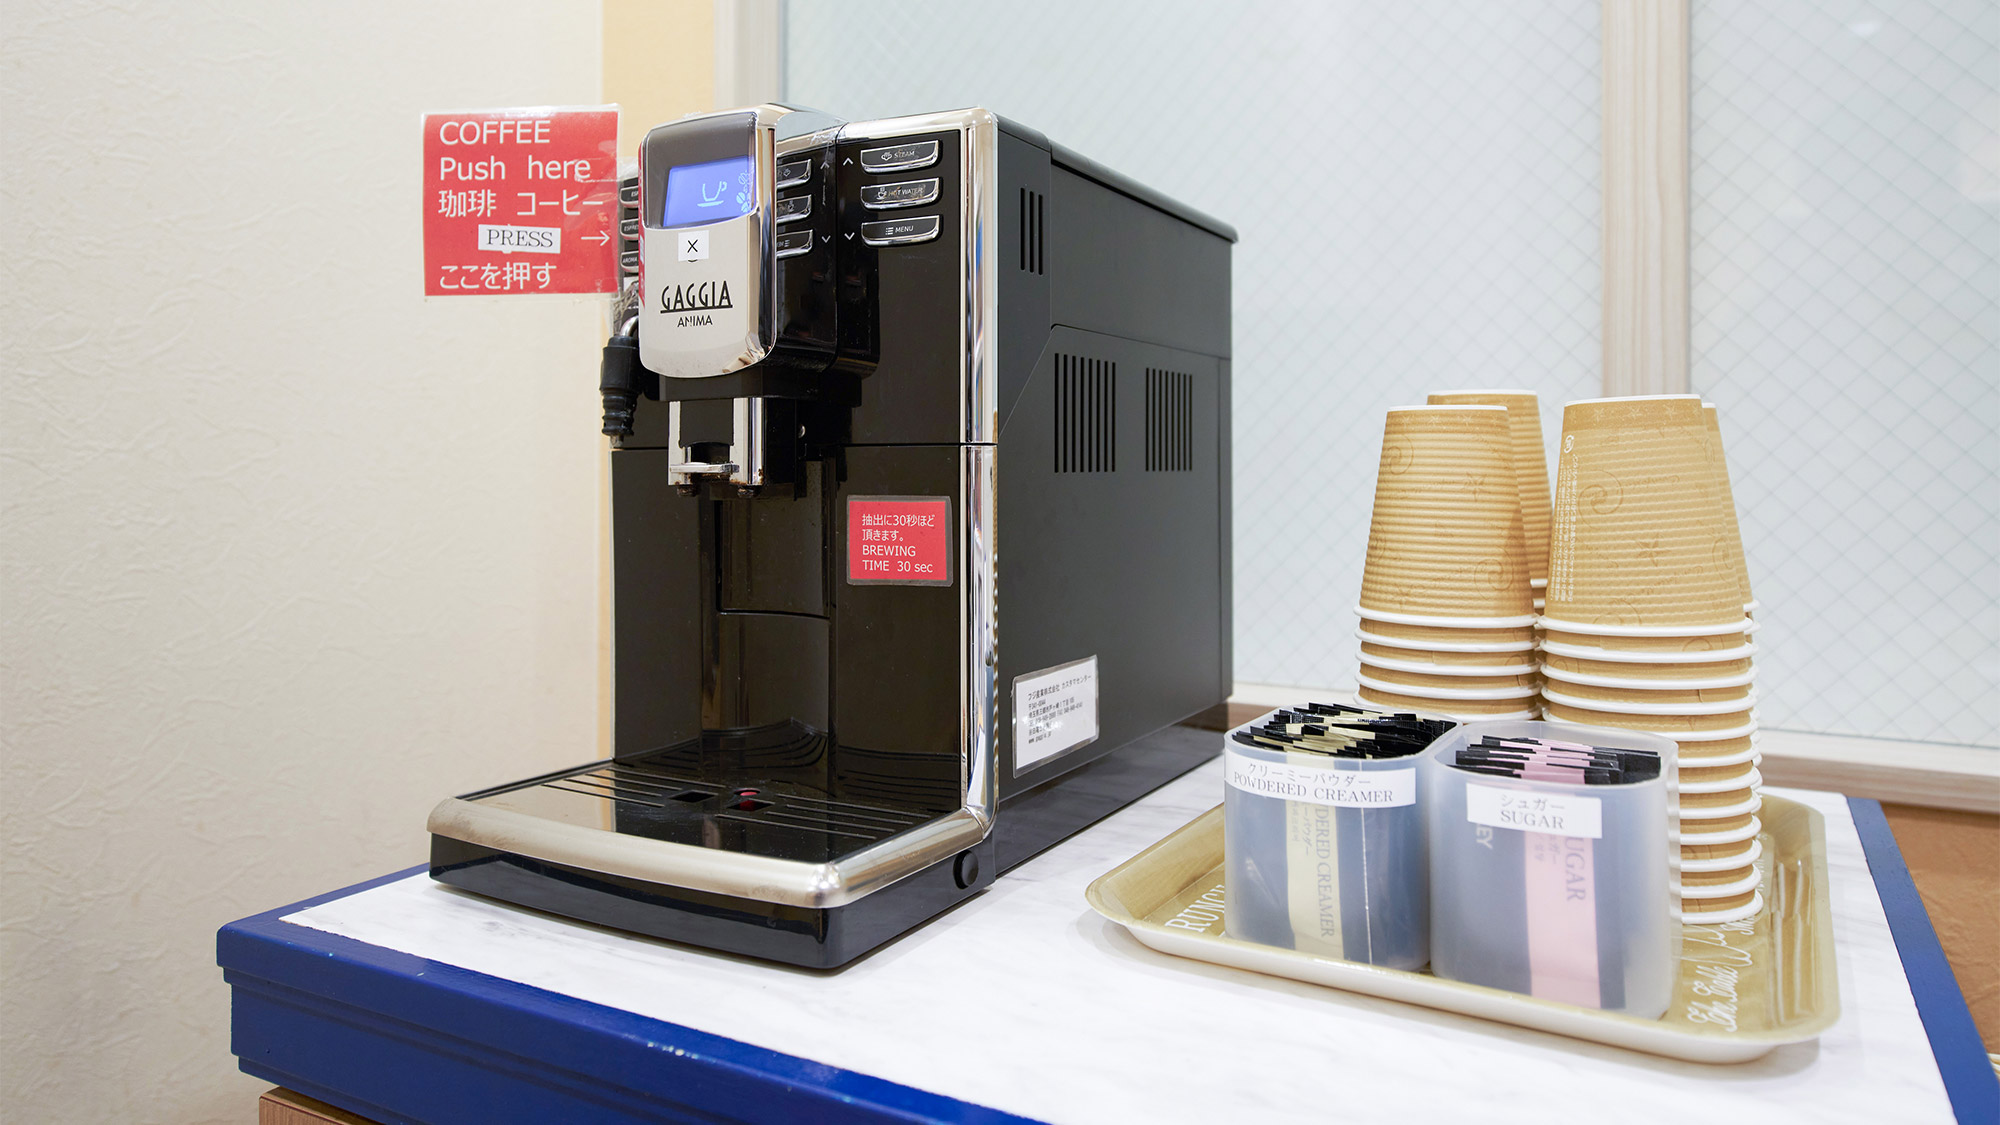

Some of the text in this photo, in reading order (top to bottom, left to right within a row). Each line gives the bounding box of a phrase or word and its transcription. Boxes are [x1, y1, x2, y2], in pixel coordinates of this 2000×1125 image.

[439, 120, 551, 145] COFFEE
[894, 150, 915, 159] STEAM
[440, 154, 591, 181] Push here
[438, 189, 604, 218] 珈琲 コーヒー
[486, 228, 554, 249] PRESS
[895, 225, 914, 233] MENU
[439, 261, 557, 290] ここを押す
[661, 280, 733, 313] GAGGIA
[677, 315, 713, 328] ANIMA
[862, 513, 936, 527] 抽出に30秒ほど
[862, 528, 904, 542] 頂きます。
[862, 544, 916, 557] BREWING
[862, 559, 934, 573] TIME 30 sec
[1233, 770, 1394, 803] POWDERED CREAMER
[1248, 762, 1371, 788] クリーミーパウダー
[1500, 794, 1566, 812] シュガー
[1500, 809, 1565, 830] SUGAR
[1476, 823, 1494, 850] EY
[1565, 837, 1587, 902] UGAR
[1316, 862, 1335, 938] CREAMER
